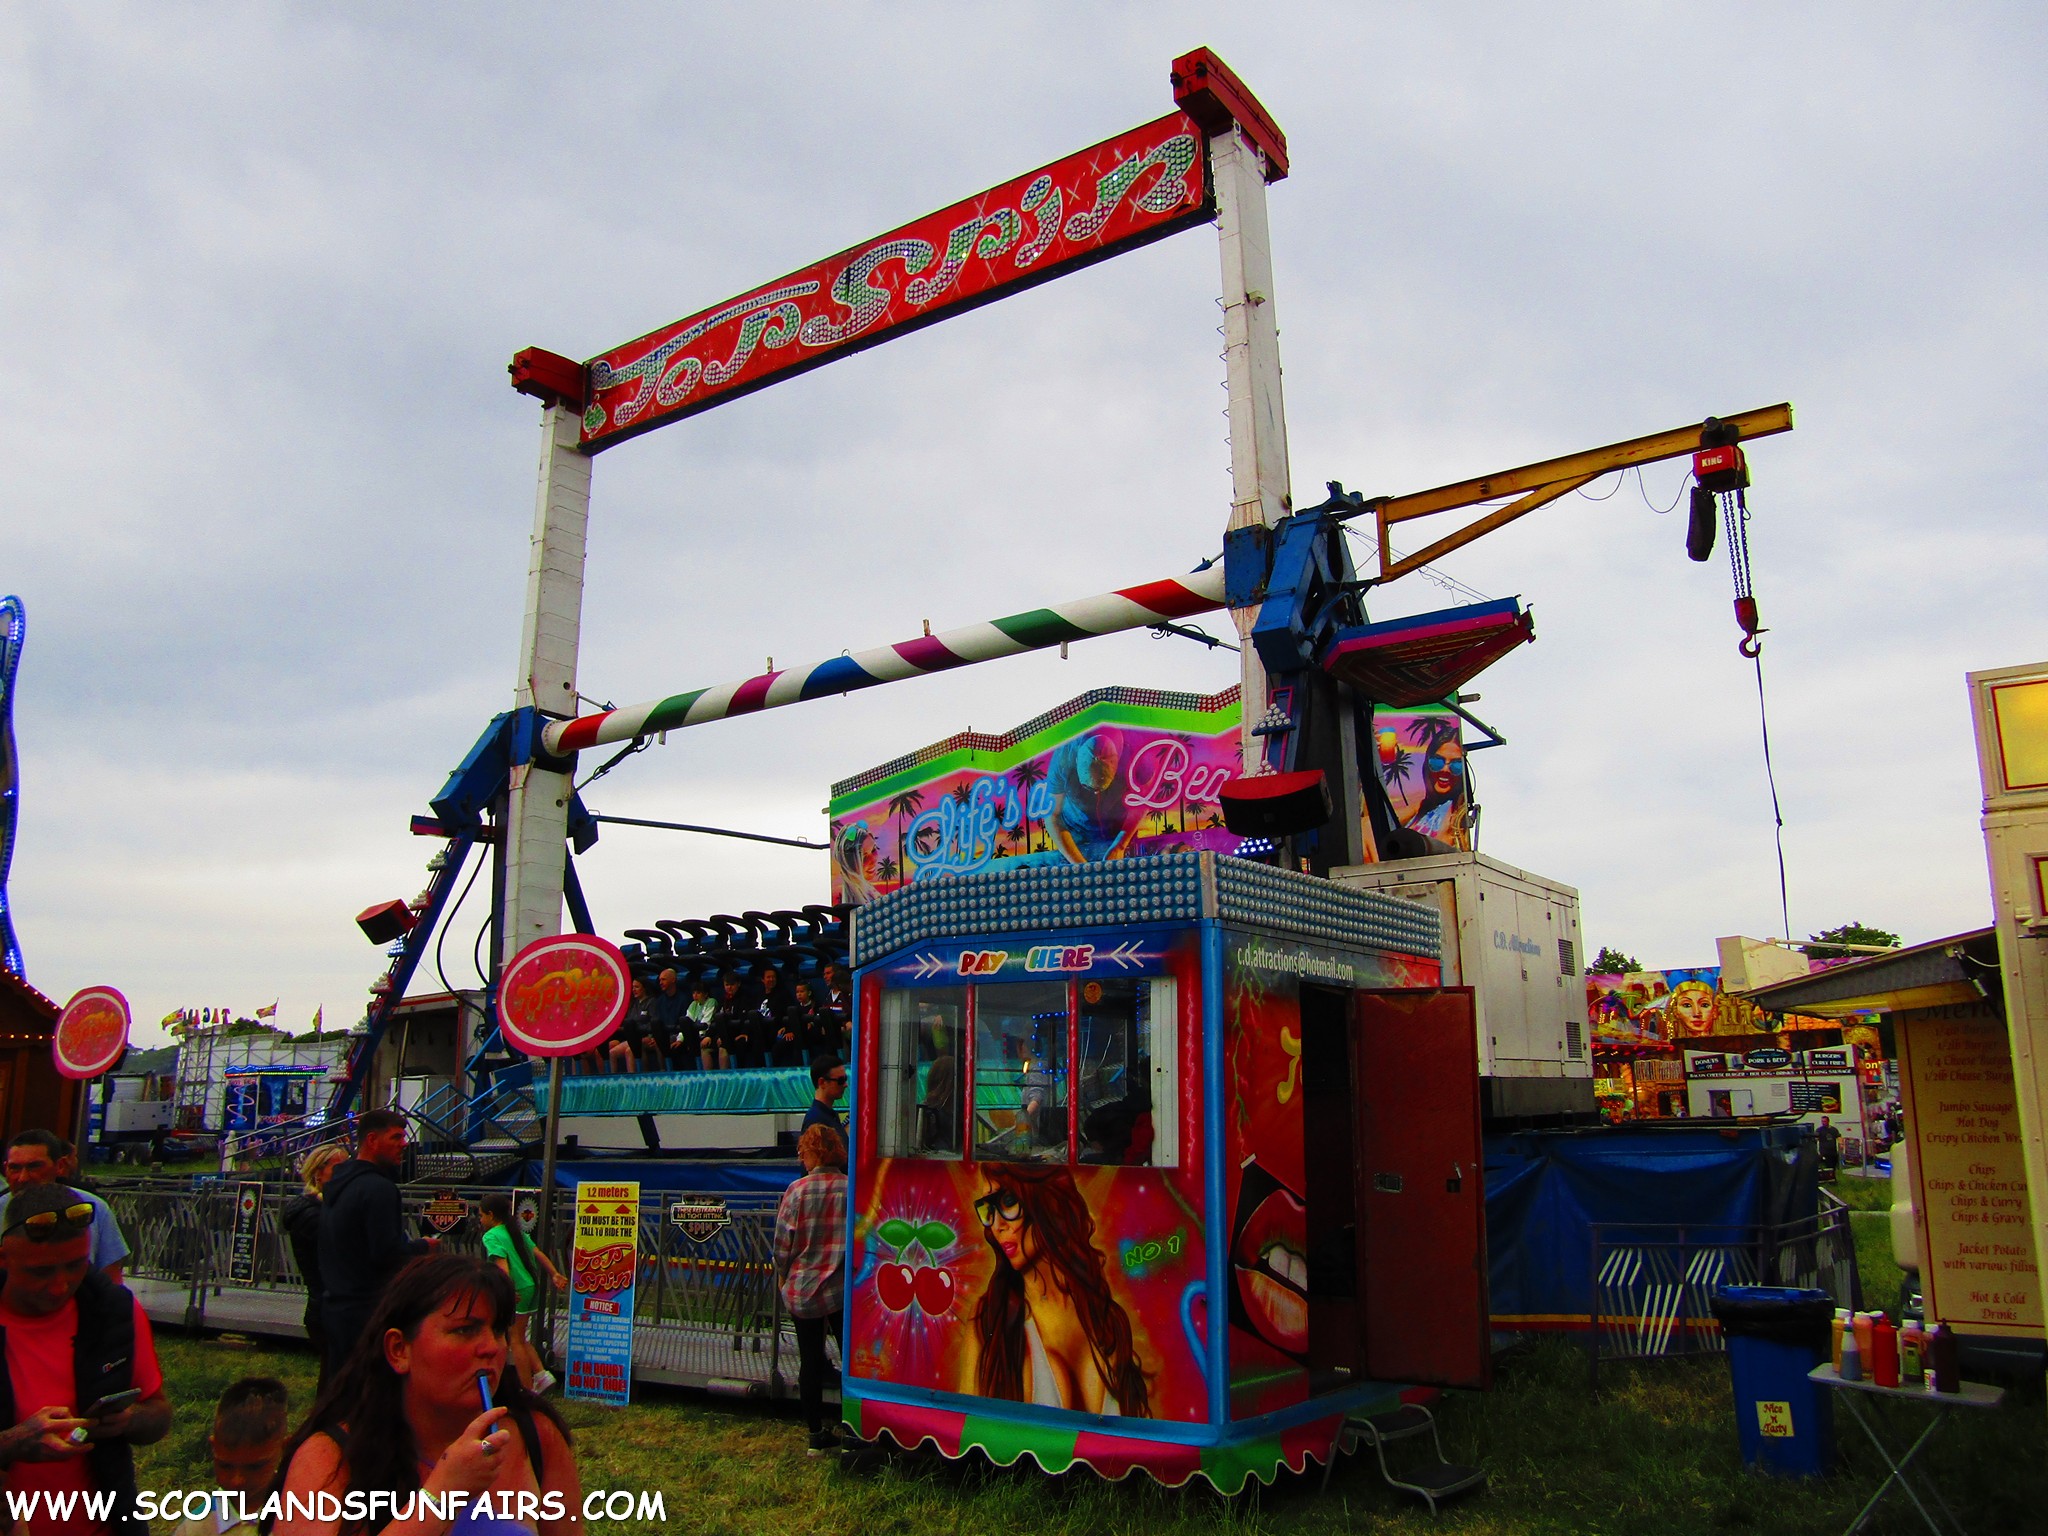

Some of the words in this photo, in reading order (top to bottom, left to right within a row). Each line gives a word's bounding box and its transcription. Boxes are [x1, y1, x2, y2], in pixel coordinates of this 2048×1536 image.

[1701, 455, 1723, 467] KING
[1027, 779, 1055, 820] a
[958, 951, 1007, 975] PAY
[1026, 945, 1094, 971] HERE
[1237, 943, 1353, 981] c.d.attractions@hotmail.com
[1695, 1058, 1719, 1066] DONUTS
[1939, 1102, 1970, 1113] Jumbo
[1974, 1102, 2012, 1115] Sausage
[1956, 1118, 1974, 1128] Hot
[1979, 1117, 1998, 1129] Dog
[1926, 1132, 1958, 1146] Crispy
[1961, 1132, 2000, 1144] Chicken
[1969, 1164, 1996, 1176] Chips
[1929, 1177, 1955, 1193] Chips
[1958, 1179, 1966, 1190] &
[1968, 1178, 2008, 1191] Chicken
[587, 1187, 597, 1197] 1.2
[598, 1187, 629, 1197] meters
[1951, 1195, 1977, 1209] Chips
[1981, 1197, 1988, 1206] &
[1991, 1197, 2022, 1211] Curry
[579, 1215, 590, 1225] YOU
[592, 1216, 610, 1225] MUST
[611, 1216, 619, 1225] BE
[620, 1216, 636, 1226] THIS
[1952, 1211, 1978, 1226] Chips
[1983, 1212, 1989, 1223] &
[1993, 1212, 2025, 1226] Gravy
[581, 1227, 594, 1236] TALL
[595, 1227, 603, 1236] TO
[605, 1227, 619, 1237] RIDE
[620, 1228, 632, 1237] THE
[688, 1221, 713, 1235] SPIN
[1167, 1235, 1180, 1254] 1
[1957, 1243, 1989, 1256] Jacket
[1994, 1244, 2026, 1255] Potato
[1944, 1257, 1966, 1270] with
[1969, 1261, 2007, 1272] various
[1971, 1291, 1989, 1303] Hot
[1993, 1292, 2000, 1304] &
[2004, 1291, 2026, 1304] Cold
[590, 1301, 613, 1312] NOTICE
[1982, 1306, 2017, 1320] Drinks
[573, 1361, 580, 1373] IF
[582, 1361, 592, 1374] IN
[594, 1362, 624, 1377] DOUBT
[569, 1374, 582, 1387] DO
[583, 1376, 600, 1389] NOT
[1763, 1403, 1783, 1413] Nice
[1764, 1423, 1787, 1435] Tasty
